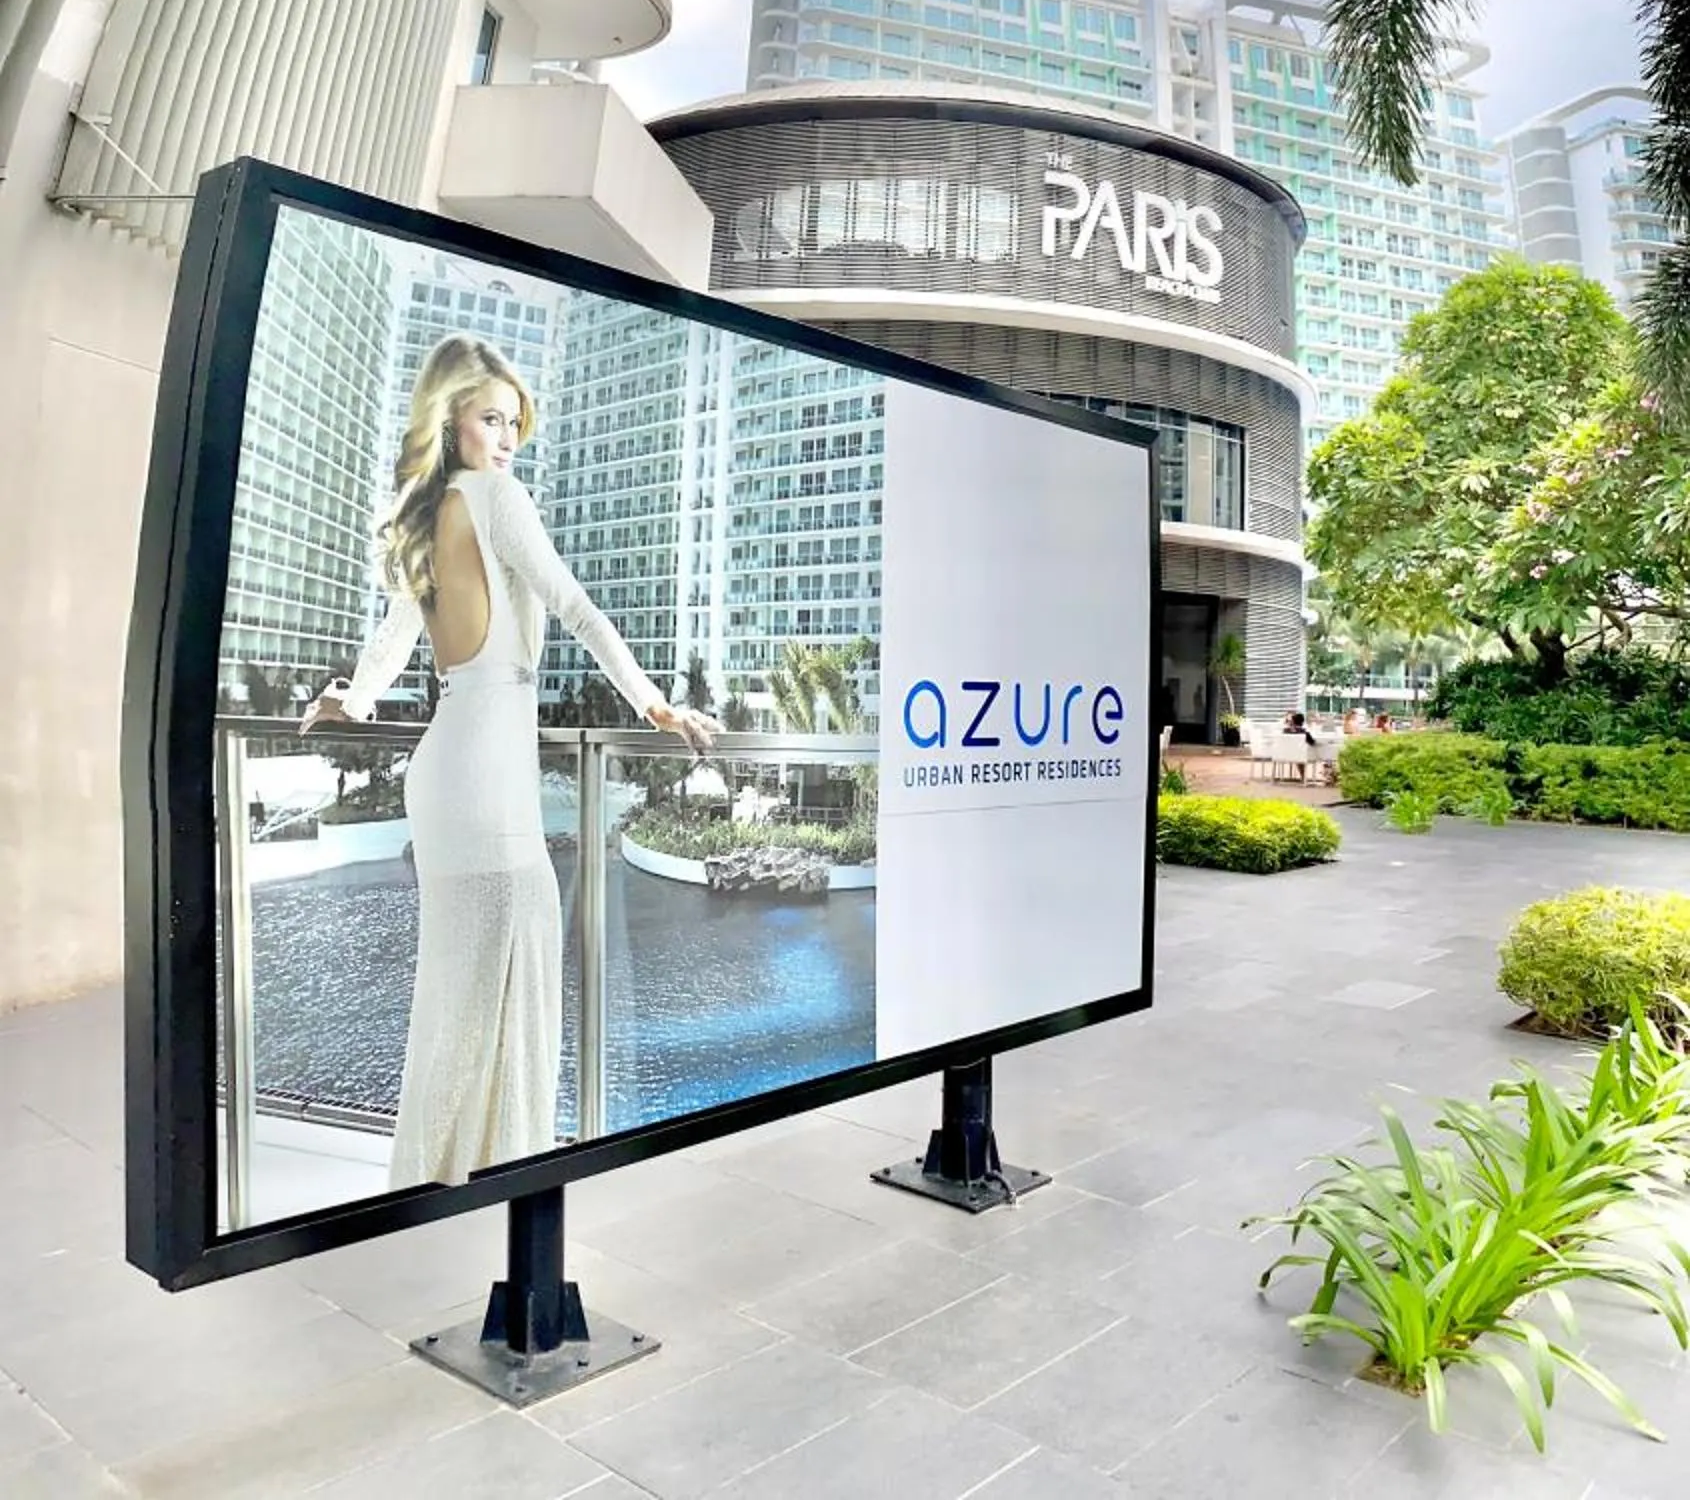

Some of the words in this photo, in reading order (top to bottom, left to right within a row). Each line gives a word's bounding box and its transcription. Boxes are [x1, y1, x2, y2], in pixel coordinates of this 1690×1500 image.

[1044, 151, 1073, 170] THE
[903, 680, 1124, 748] azure
[904, 763, 964, 788] URBAN
[971, 760, 1032, 783] RESORT
[1037, 758, 1122, 780] RESIDENCES
